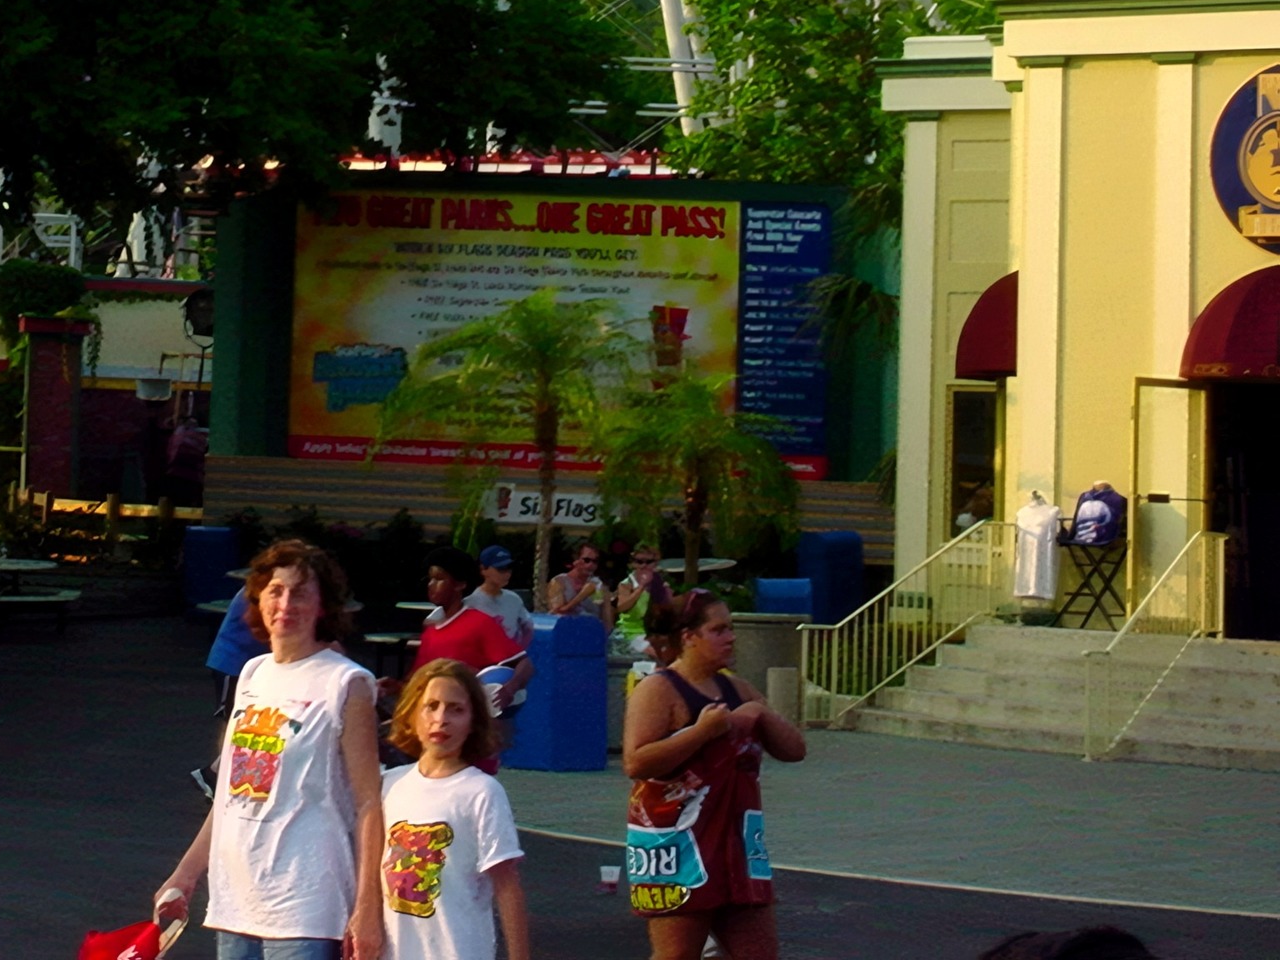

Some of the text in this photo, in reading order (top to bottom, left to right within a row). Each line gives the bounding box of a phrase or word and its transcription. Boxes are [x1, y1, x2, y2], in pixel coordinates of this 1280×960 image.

[367, 196, 435, 230] GREAT
[587, 203, 656, 236] GREAT
[661, 205, 726, 239] PASS!
[519, 496, 545, 517] Si
